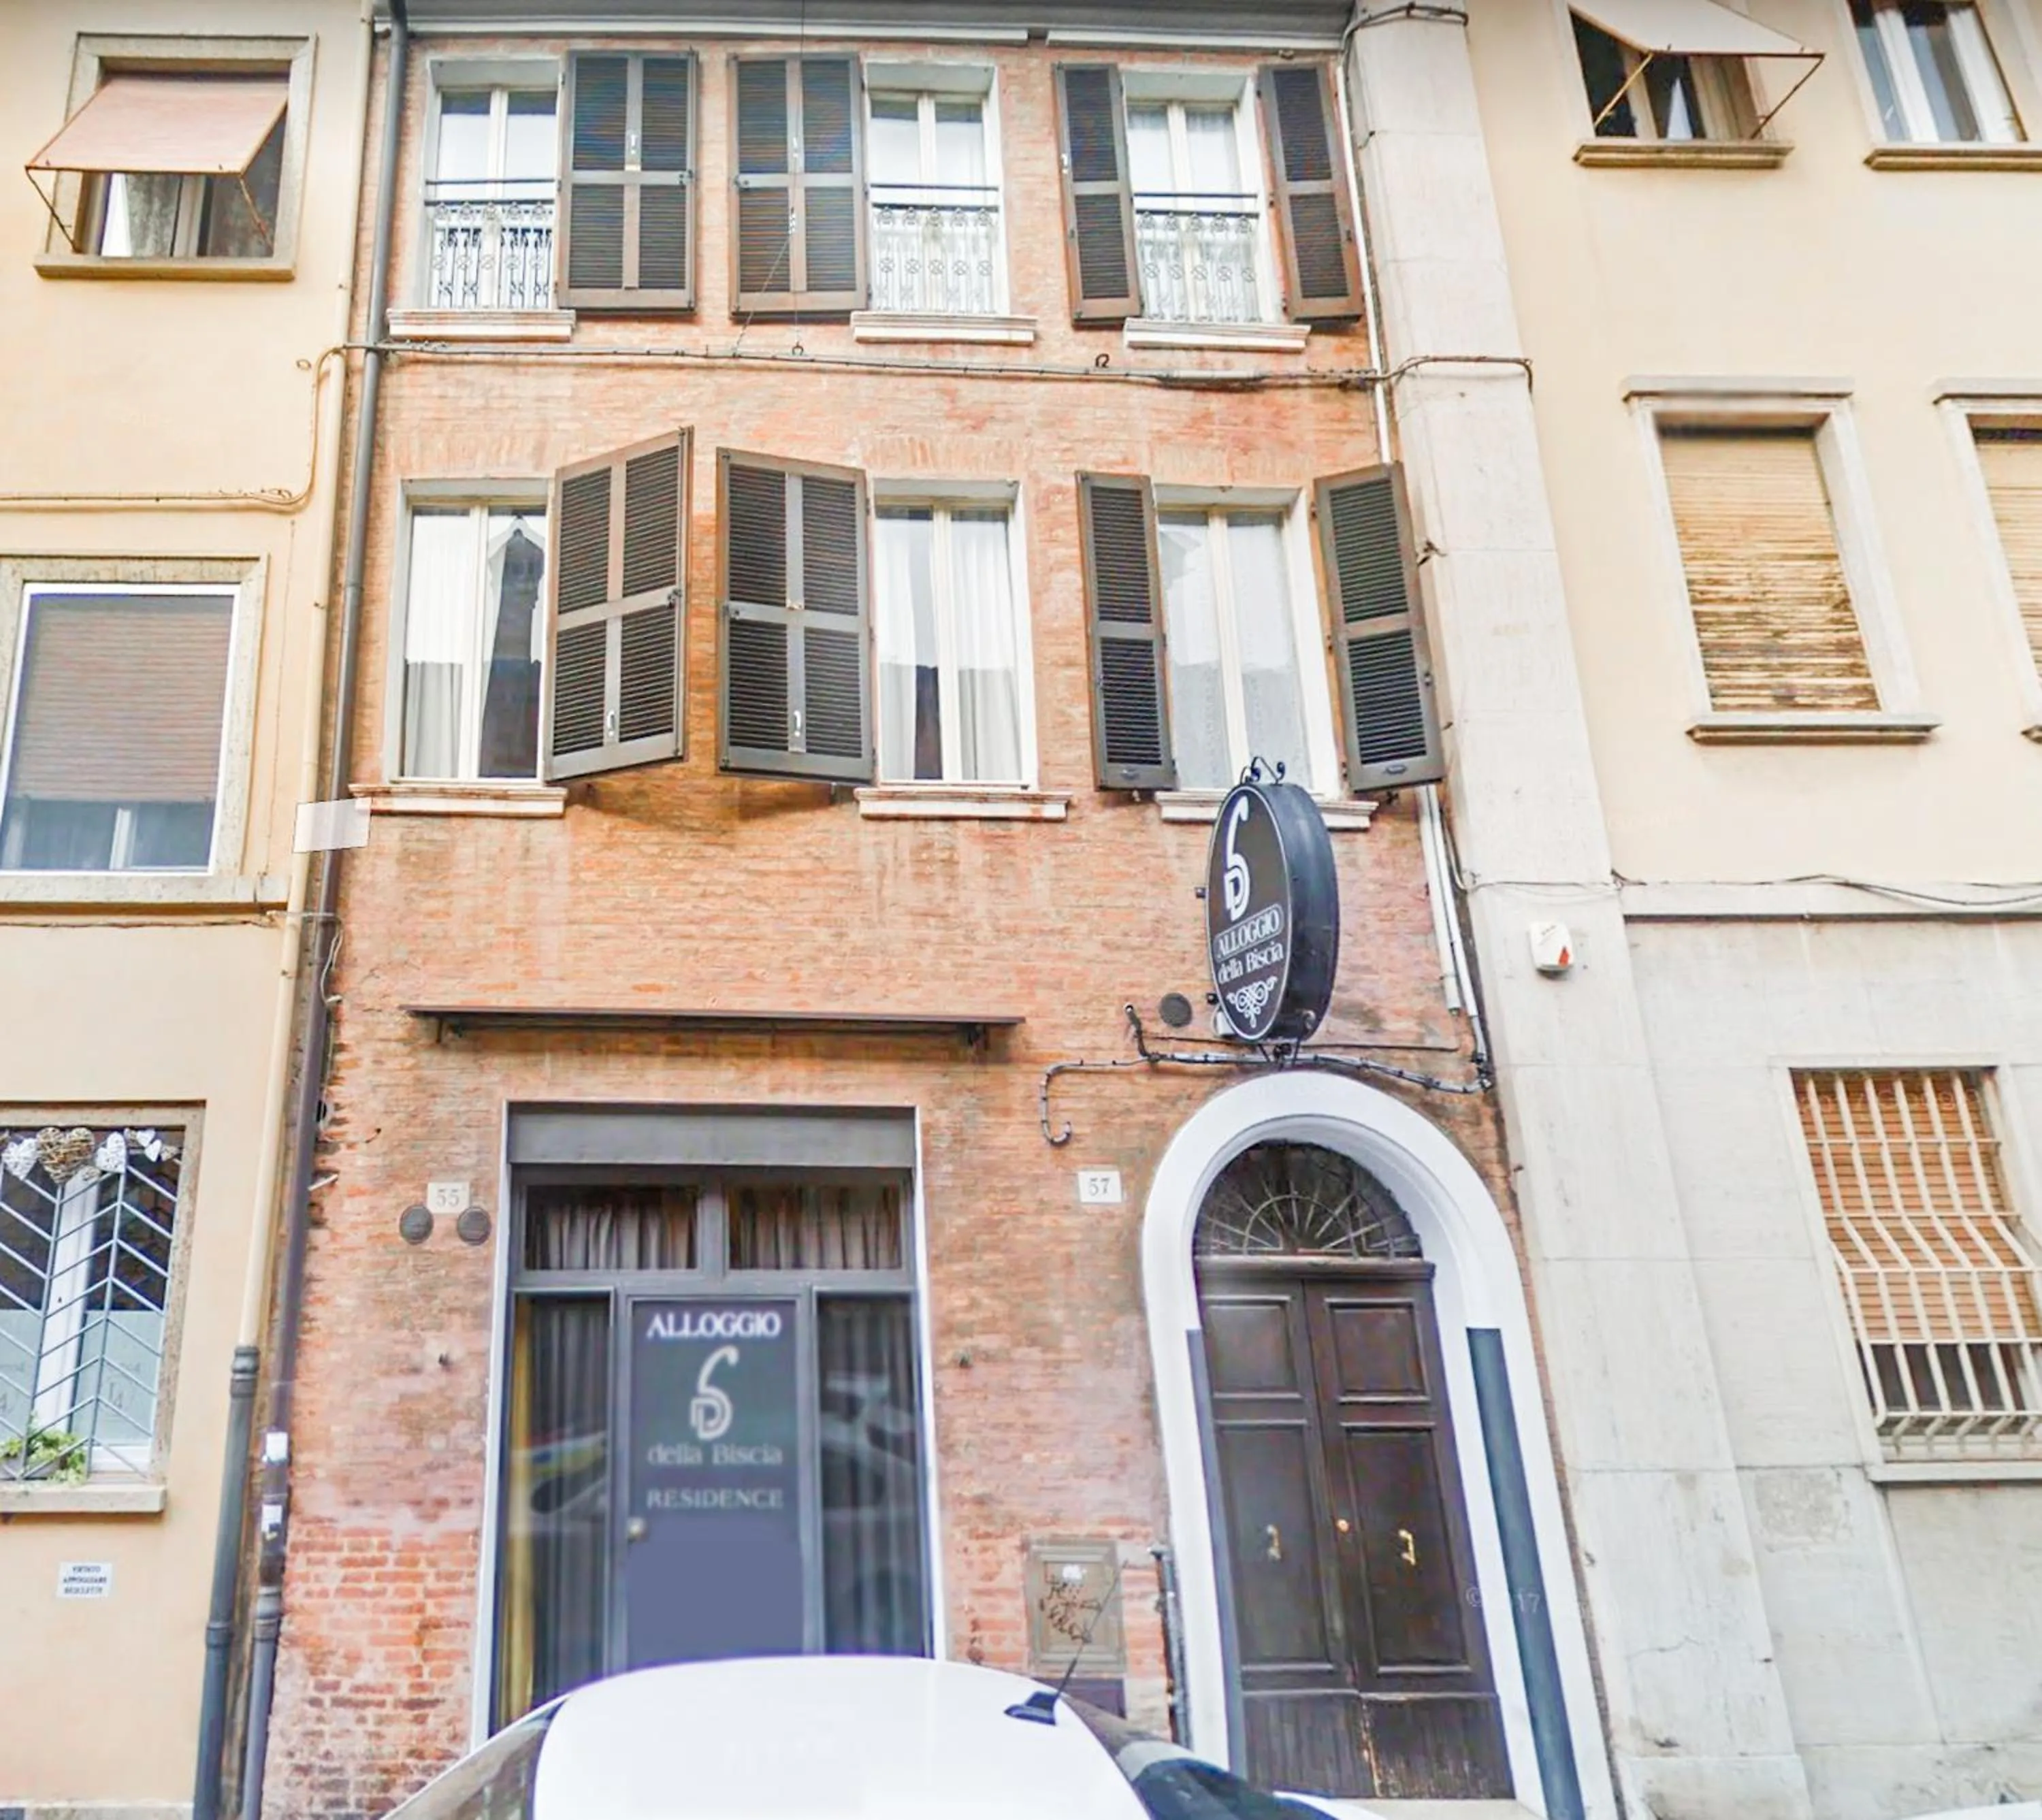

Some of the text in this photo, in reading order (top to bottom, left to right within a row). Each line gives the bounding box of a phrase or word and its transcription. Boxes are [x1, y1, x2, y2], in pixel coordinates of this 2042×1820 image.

[1217, 909, 1280, 959] ALLOGGIO
[1218, 941, 1284, 985] della Biscia
[436, 1188, 460, 1207] 55
[1088, 1177, 1111, 1197] 57
[646, 1311, 782, 1339] ALLOGGIO
[647, 1442, 783, 1466] della Biscia
[646, 1486, 783, 1510] RESIDENCE
